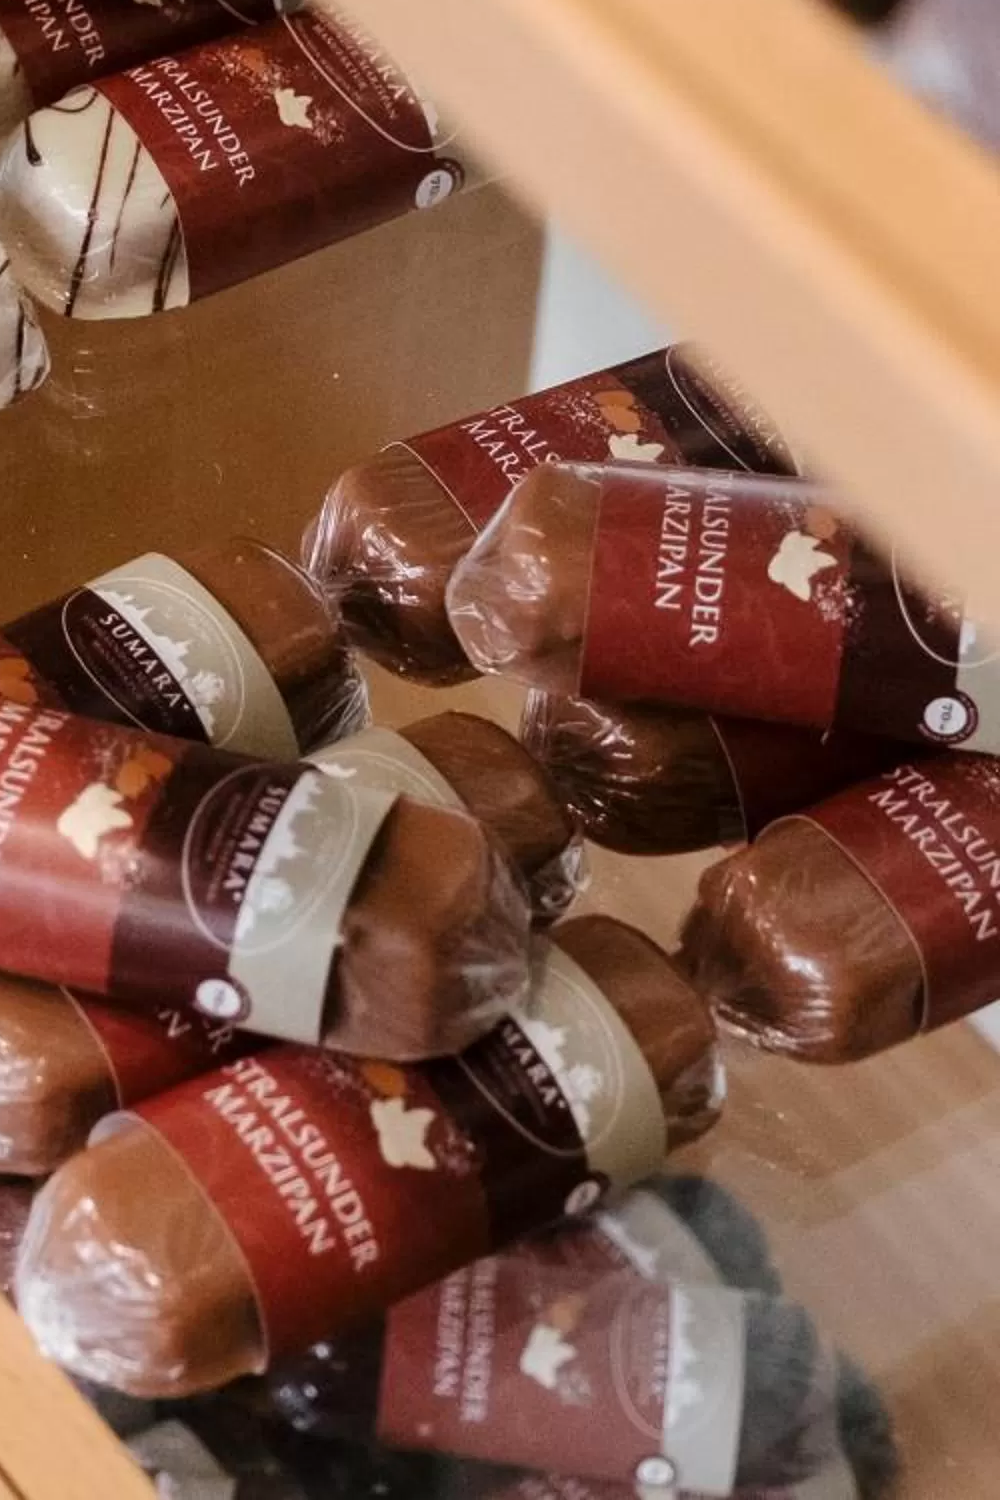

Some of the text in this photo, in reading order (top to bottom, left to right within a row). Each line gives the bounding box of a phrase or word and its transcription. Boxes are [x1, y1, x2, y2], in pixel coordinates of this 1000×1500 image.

[121, 66, 219, 172] MARZIPAN
[460, 419, 530, 486] MARZ
[99, 612, 183, 708] SUMARA
[867, 788, 999, 942] MARZIPAN
[502, 1022, 560, 1107] MARA
[203, 1083, 337, 1257] MARZIPAN
